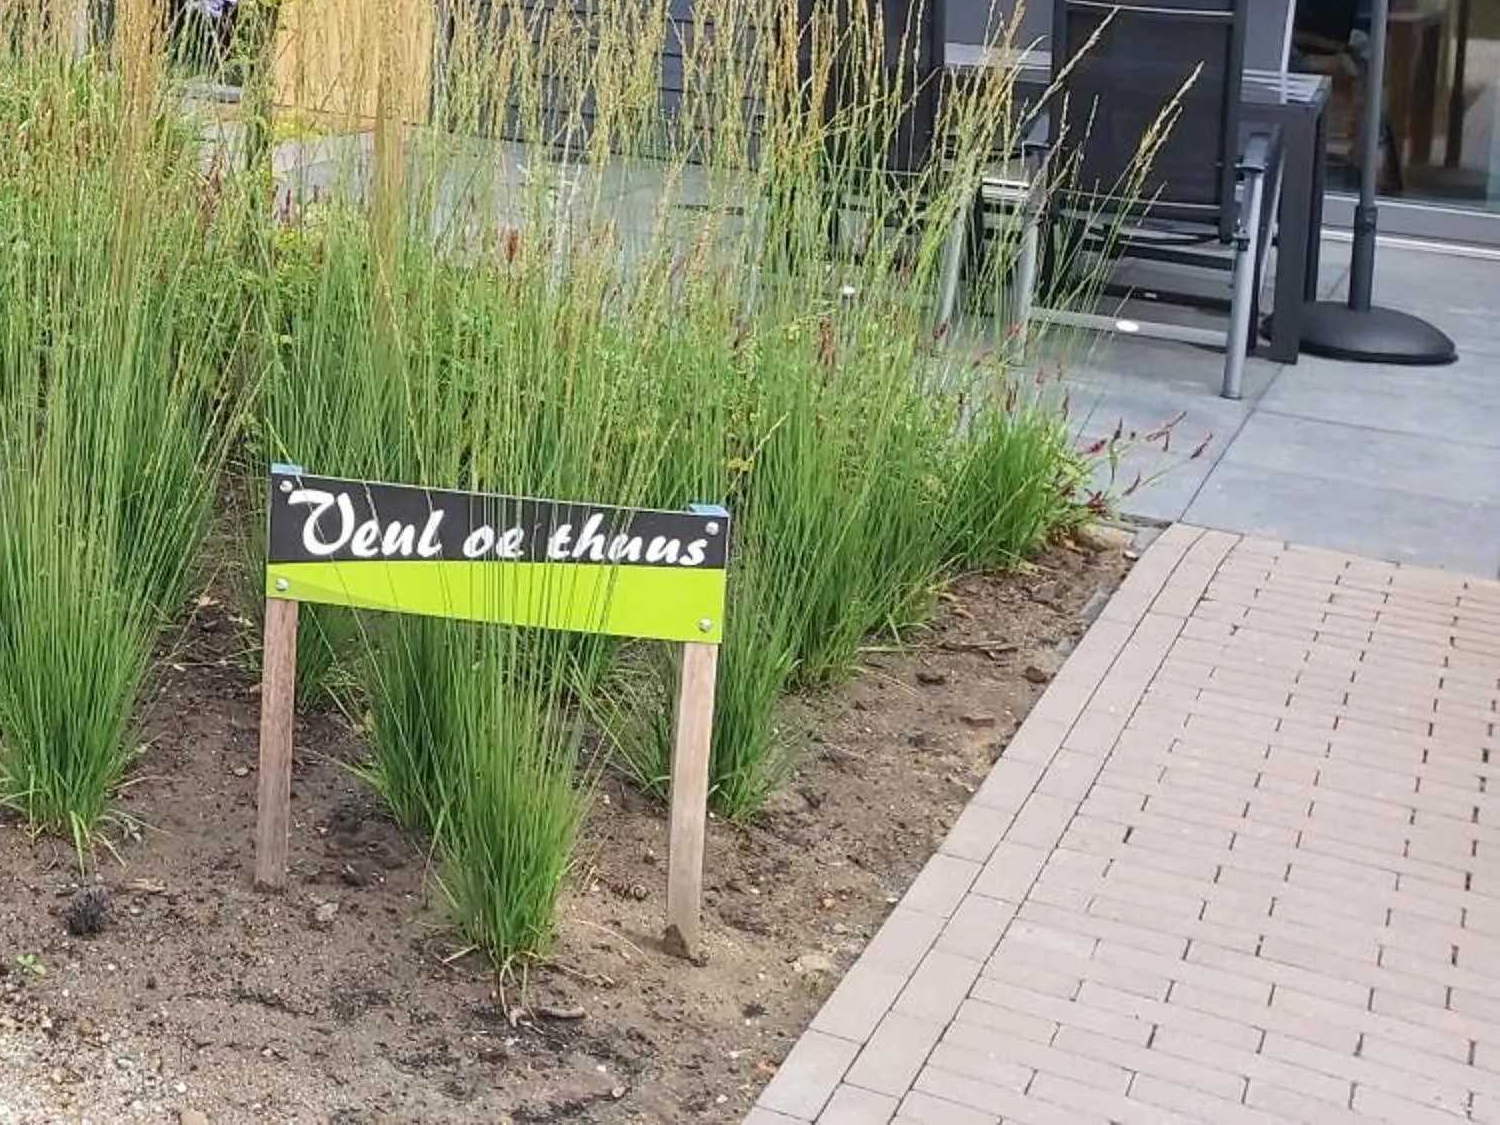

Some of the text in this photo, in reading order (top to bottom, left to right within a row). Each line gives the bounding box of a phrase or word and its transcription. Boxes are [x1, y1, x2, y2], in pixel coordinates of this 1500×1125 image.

[287, 489, 708, 566] Veul oe thuus
